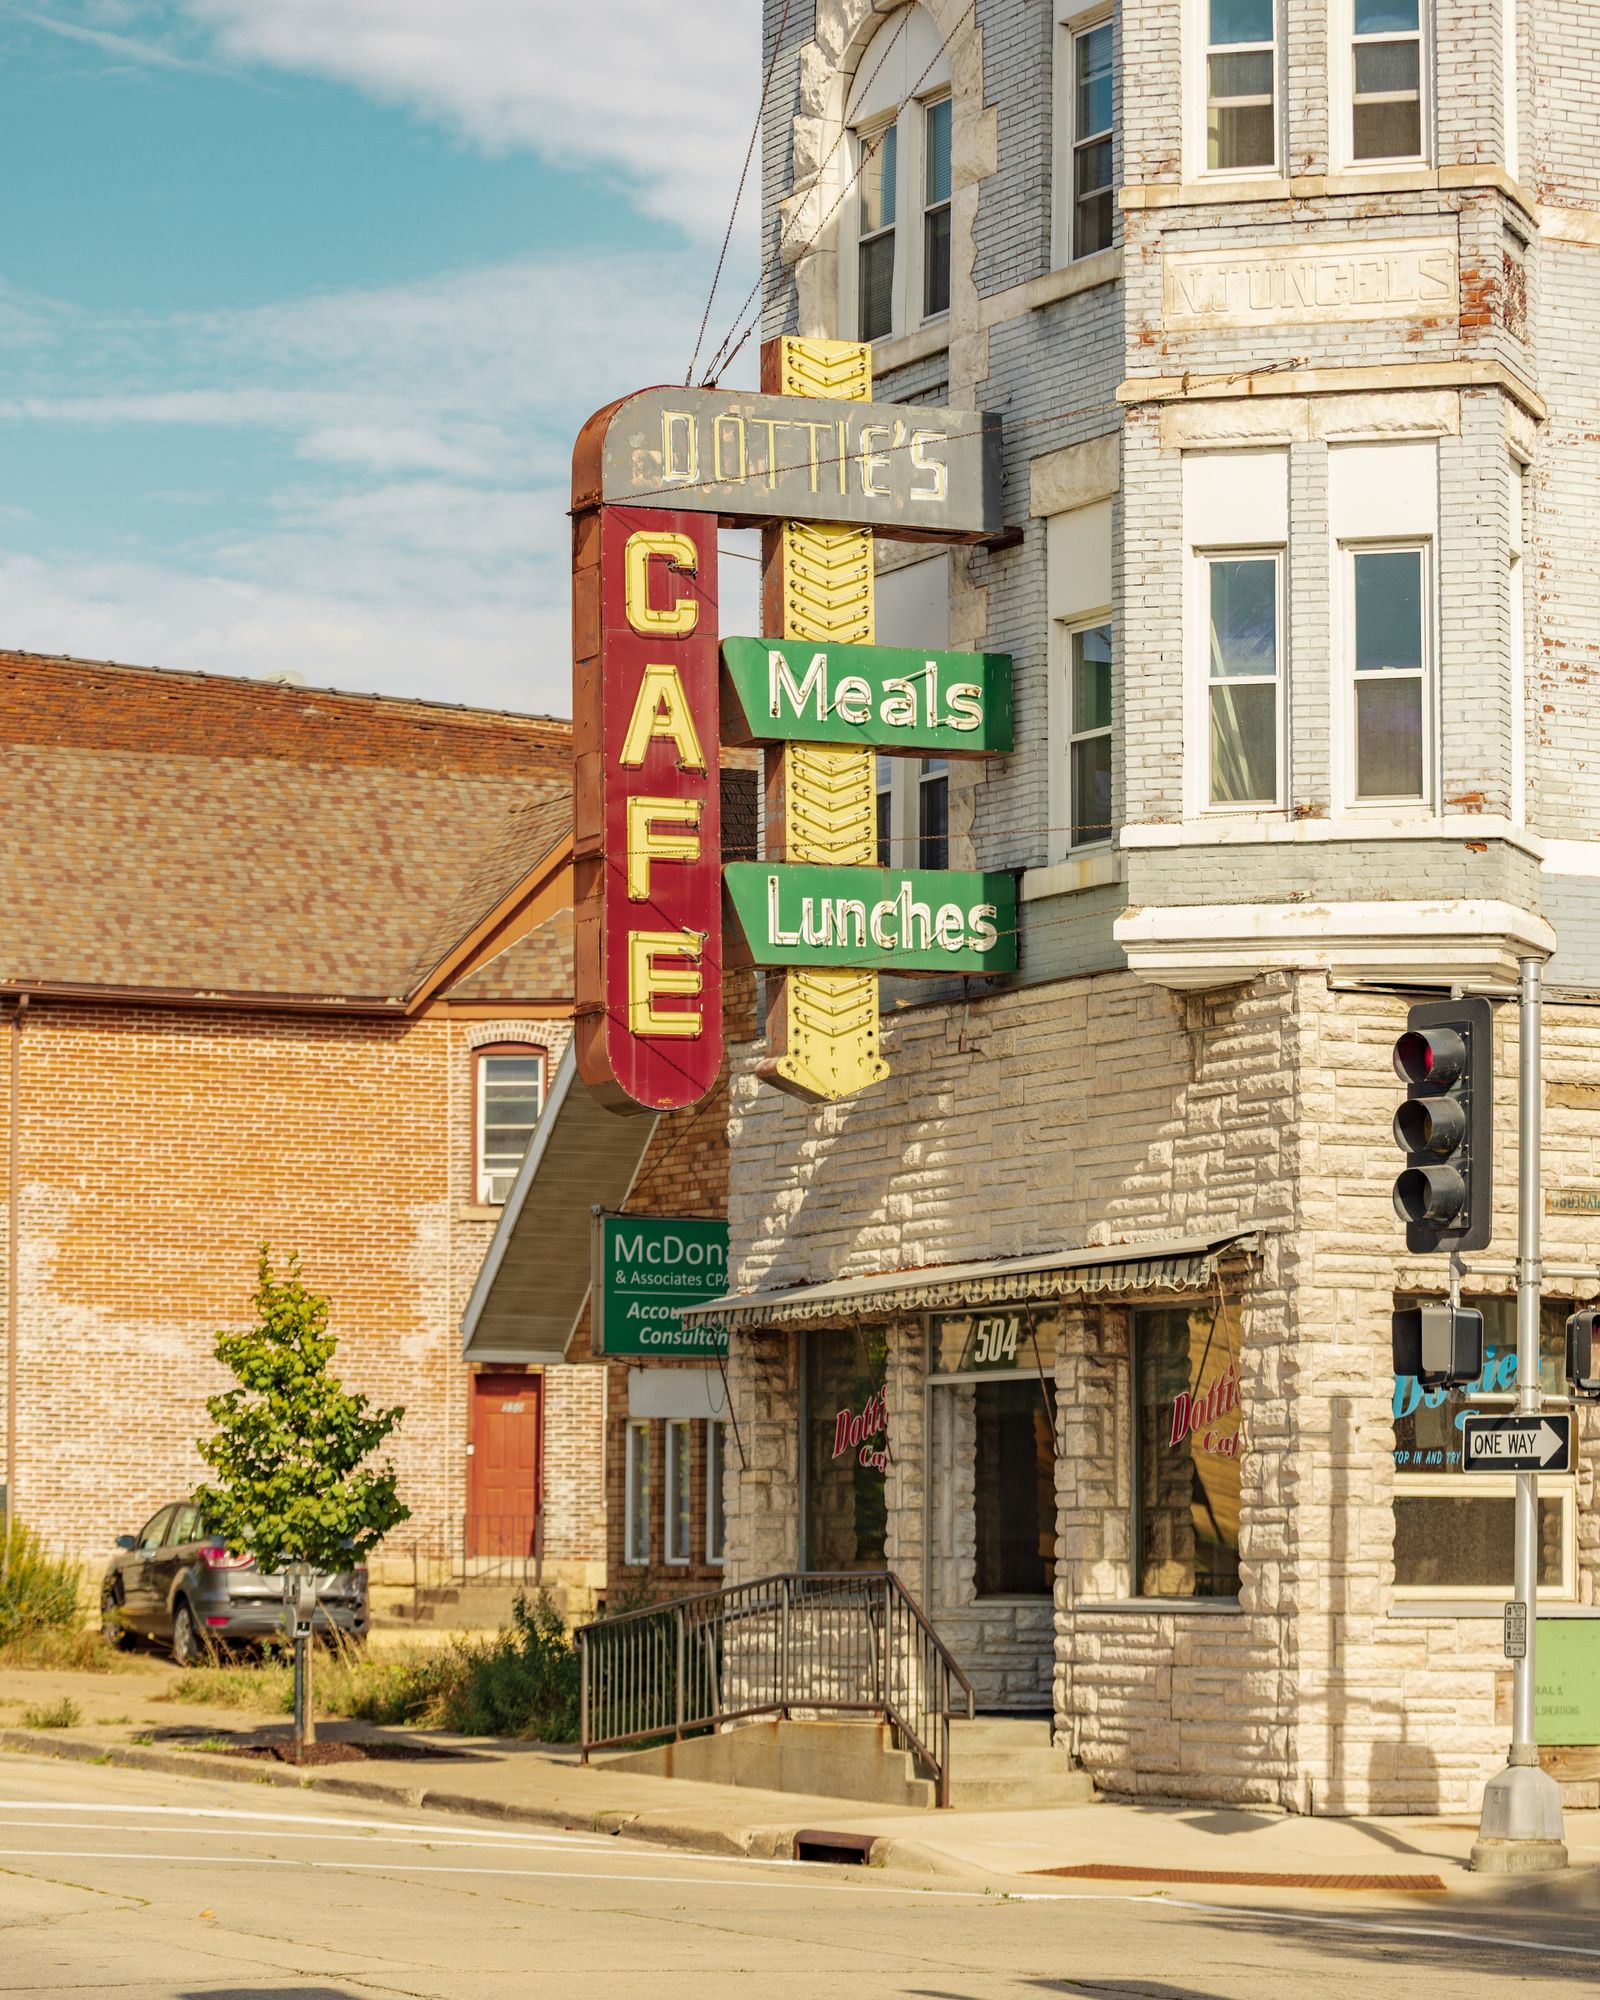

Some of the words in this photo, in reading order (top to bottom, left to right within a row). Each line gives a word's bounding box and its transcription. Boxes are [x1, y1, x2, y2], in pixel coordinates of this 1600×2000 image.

[661, 409, 948, 502] DOTTIE'S
[768, 650, 984, 731] Meals
[618, 531, 706, 1037] CAFE
[767, 875, 997, 952] Lunches
[614, 1233, 729, 1266] McDon
[616, 1270, 627, 1285] &
[631, 1271, 702, 1287] Associates
[975, 1318, 1019, 1363] 504
[832, 1384, 889, 1459] Dotti
[1474, 1434, 1502, 1455] ONE
[1508, 1433, 1537, 1454] WAY
[1393, 1451, 1410, 1465] TOP
[1413, 1451, 1422, 1465] IN
[1425, 1450, 1443, 1465] AND
[1446, 1450, 1462, 1465] TRY
